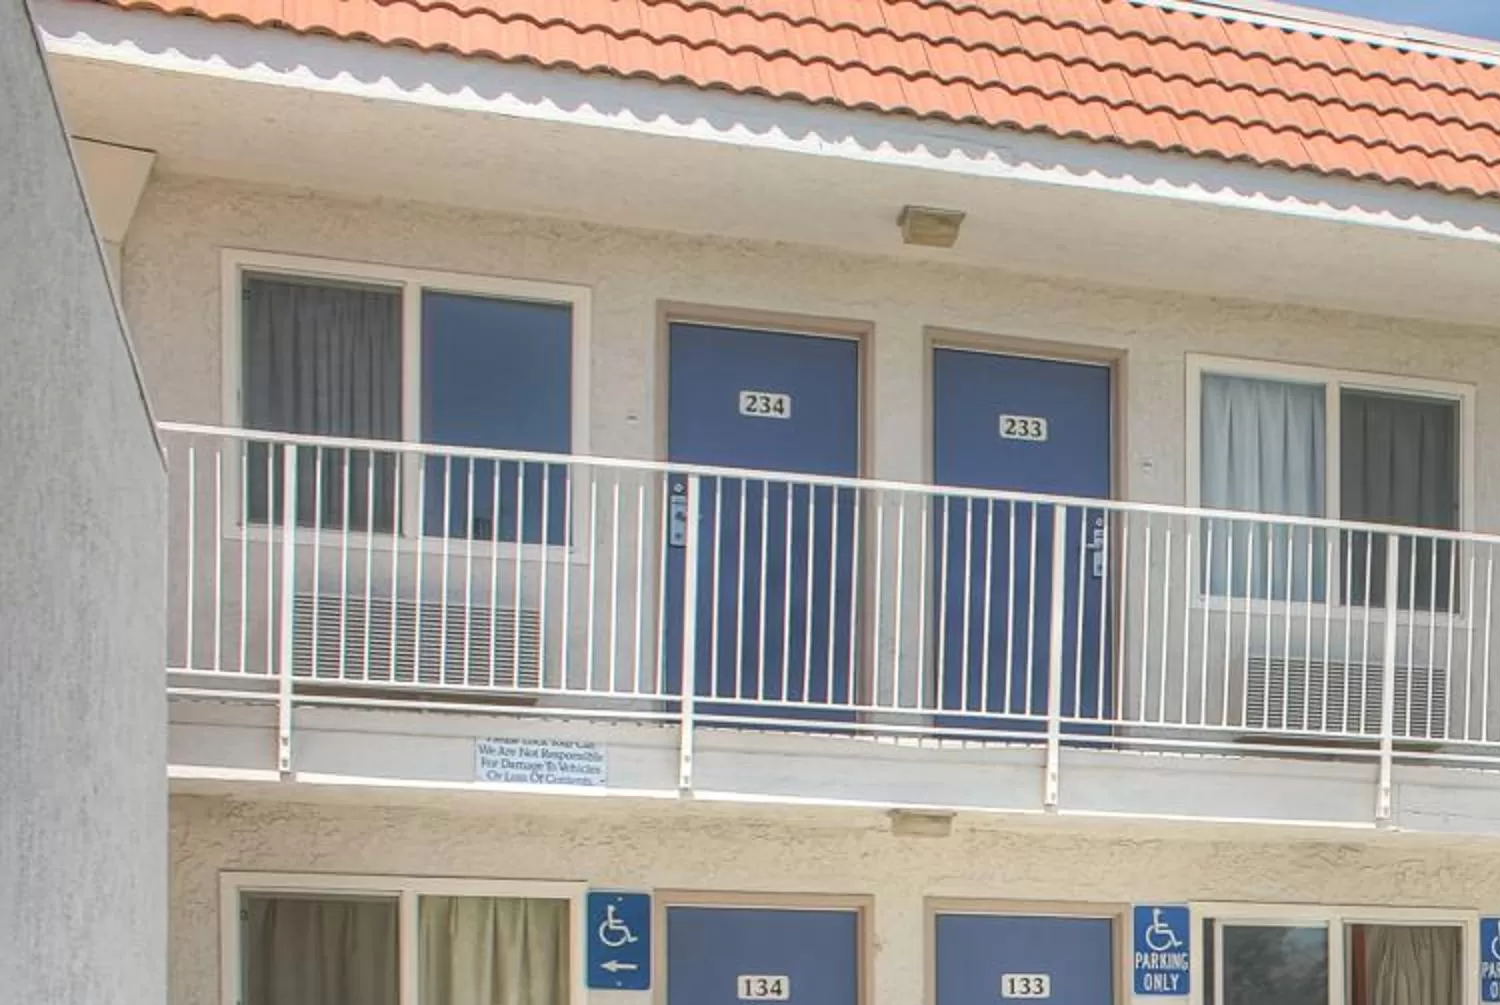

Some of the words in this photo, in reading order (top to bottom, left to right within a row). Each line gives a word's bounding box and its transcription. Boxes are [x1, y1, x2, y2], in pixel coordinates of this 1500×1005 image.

[744, 394, 786, 416] 234
[1004, 417, 1043, 438] 233
[1135, 952, 1189, 970] PARKING
[744, 978, 783, 998] 134
[1007, 976, 1045, 995] 133
[1143, 972, 1180, 992] ONLY
